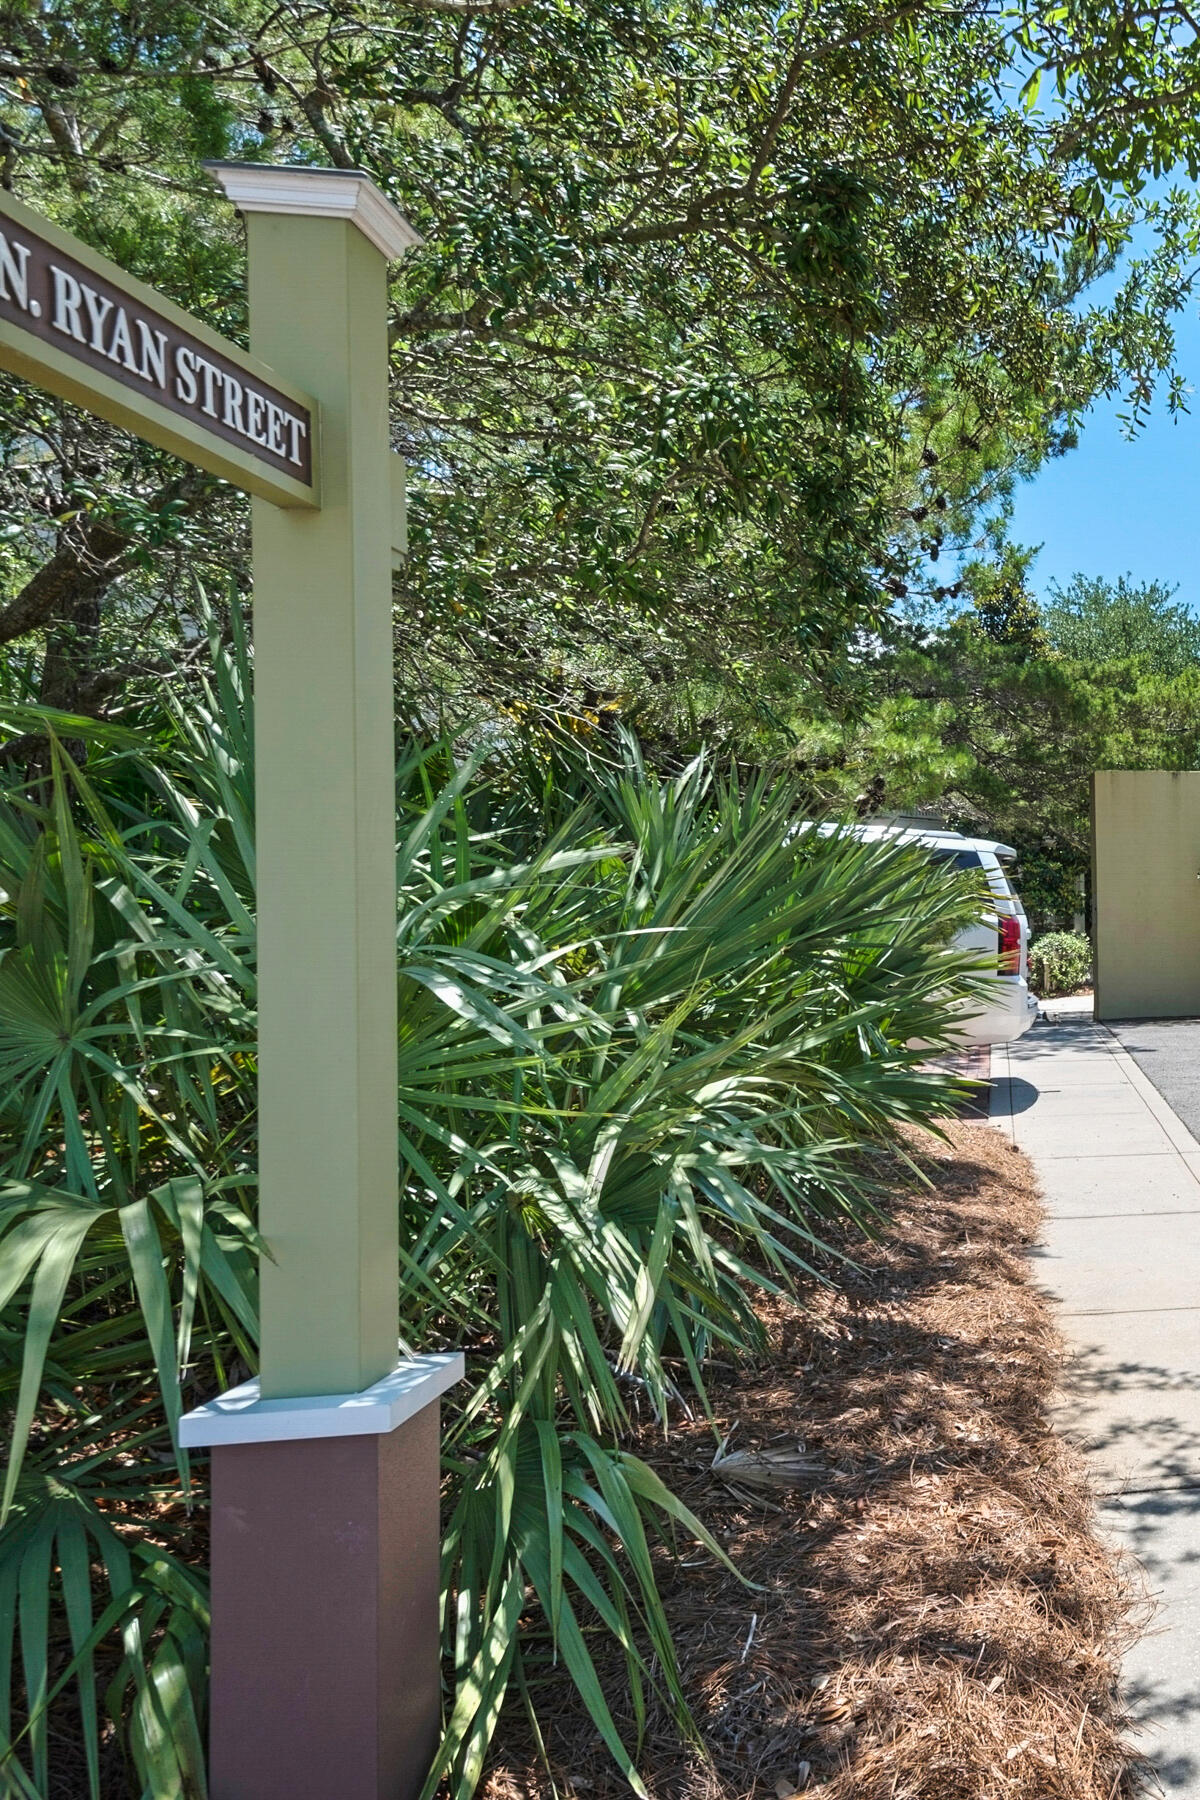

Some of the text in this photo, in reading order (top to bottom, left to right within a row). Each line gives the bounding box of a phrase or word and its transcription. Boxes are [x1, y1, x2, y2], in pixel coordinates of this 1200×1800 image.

[0, 229, 307, 468] N. RYAN STREET
